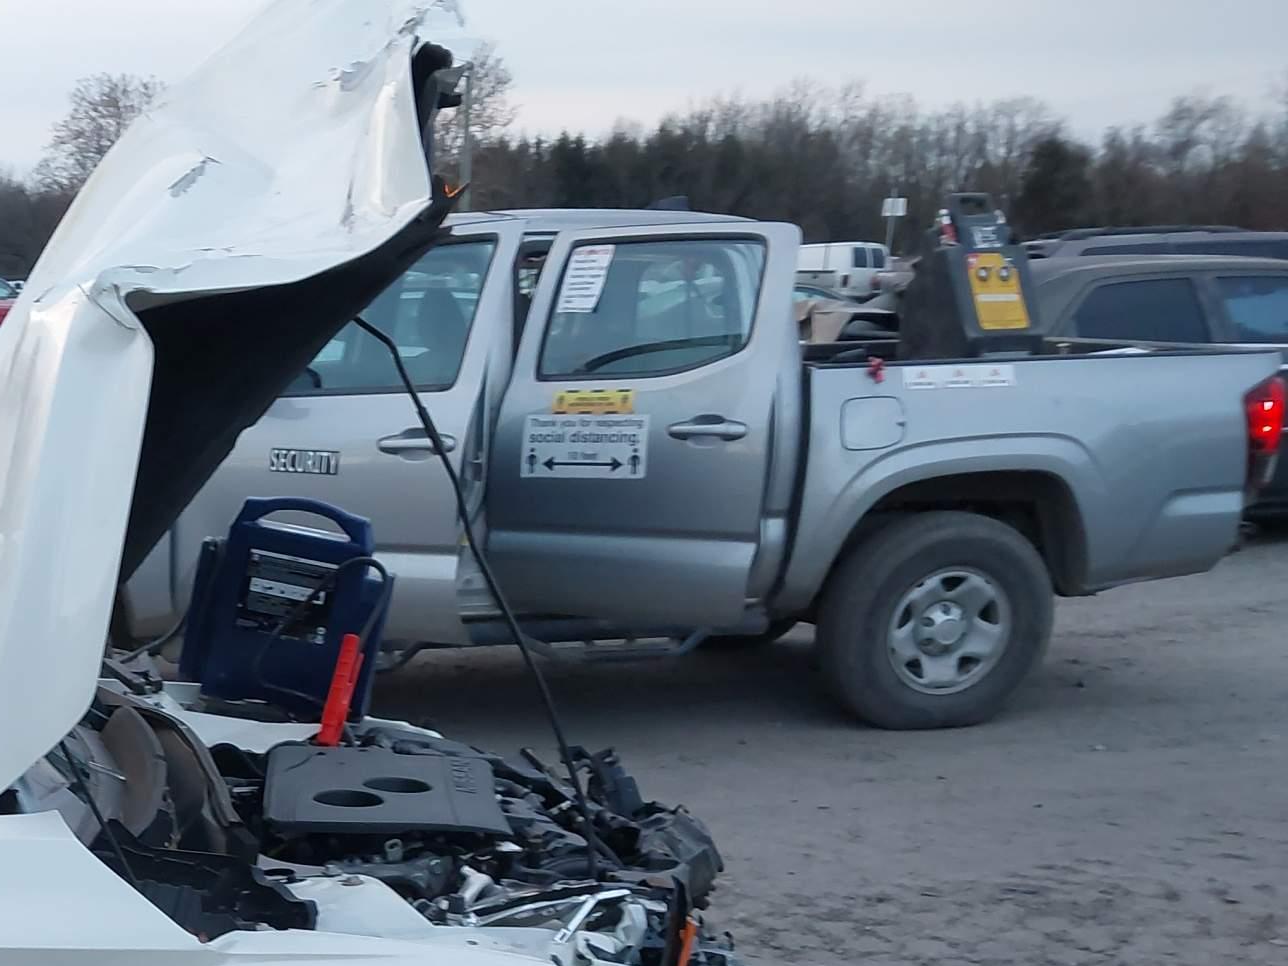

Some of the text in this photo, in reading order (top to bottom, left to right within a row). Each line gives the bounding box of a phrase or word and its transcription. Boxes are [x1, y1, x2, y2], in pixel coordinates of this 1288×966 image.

[530, 418, 644, 430] Thank you for respecting
[528, 431, 640, 446] social distancing.
[270, 449, 339, 475] SECURITY
